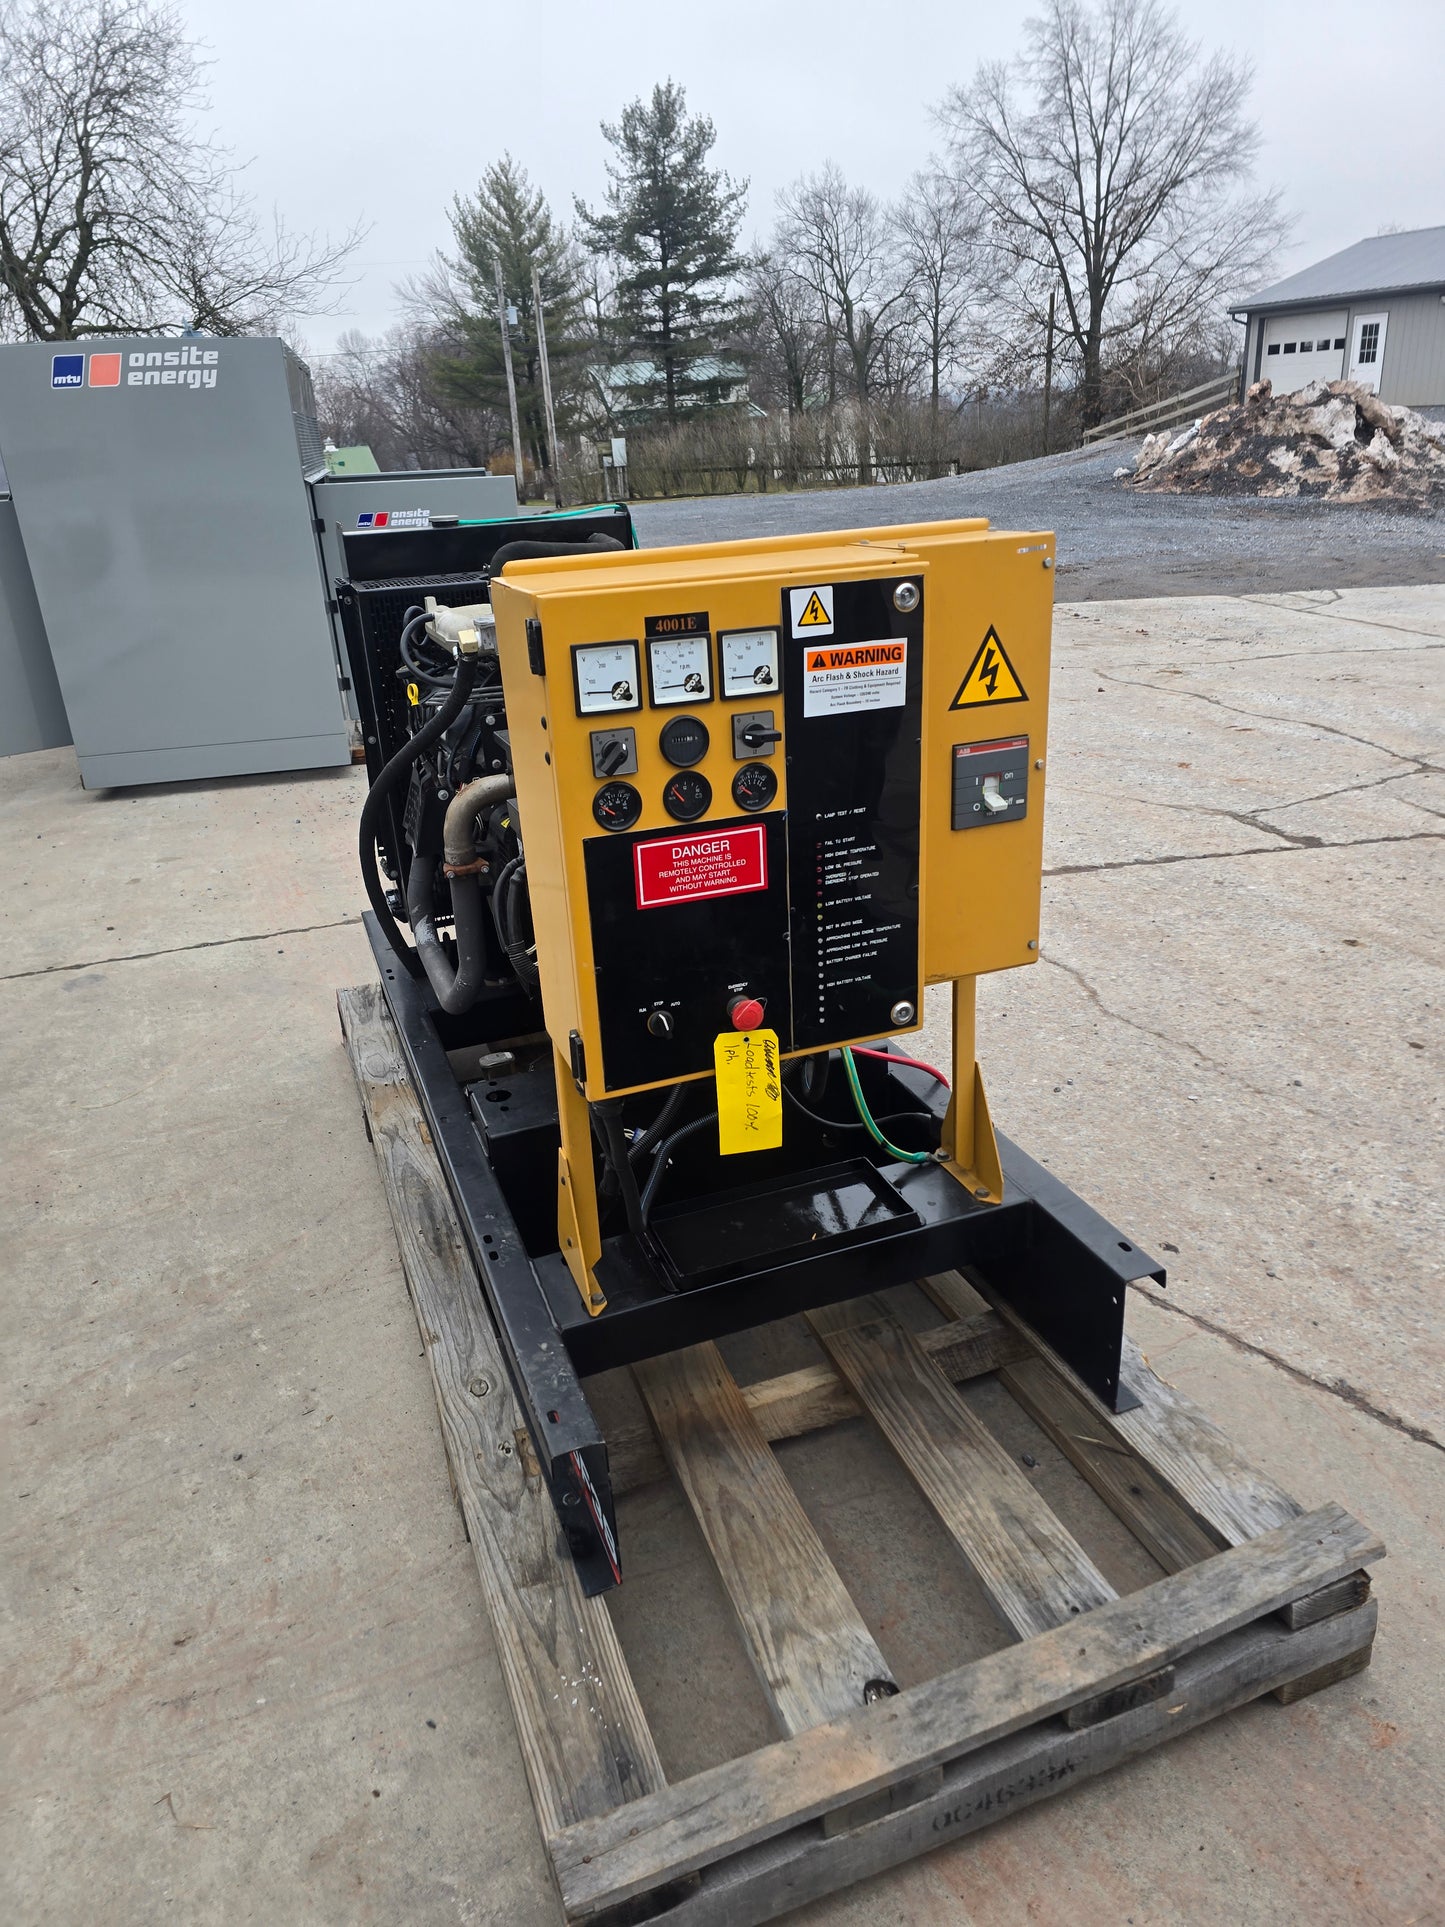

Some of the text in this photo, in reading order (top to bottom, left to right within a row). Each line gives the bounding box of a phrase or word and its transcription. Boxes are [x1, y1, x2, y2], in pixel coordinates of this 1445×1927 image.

[128, 346, 218, 367] onsite
[53, 374, 81, 384] mtu
[127, 369, 217, 389] energy
[391, 508, 430, 518] onsite
[390, 518, 429, 527] energy
[655, 617, 697, 632] 4001E
[829, 646, 903, 667] WARNING
[812, 667, 899, 683] Arc Flash & Shock Hazard
[672, 839, 730, 860] DANGER
[658, 859, 747, 879] REMOTELY CONTROLLED
[672, 852, 732, 869] THIS MACHINE IS
[669, 876, 738, 893] WITHOUT WARNING
[675, 869, 731, 884] AND MAY START
